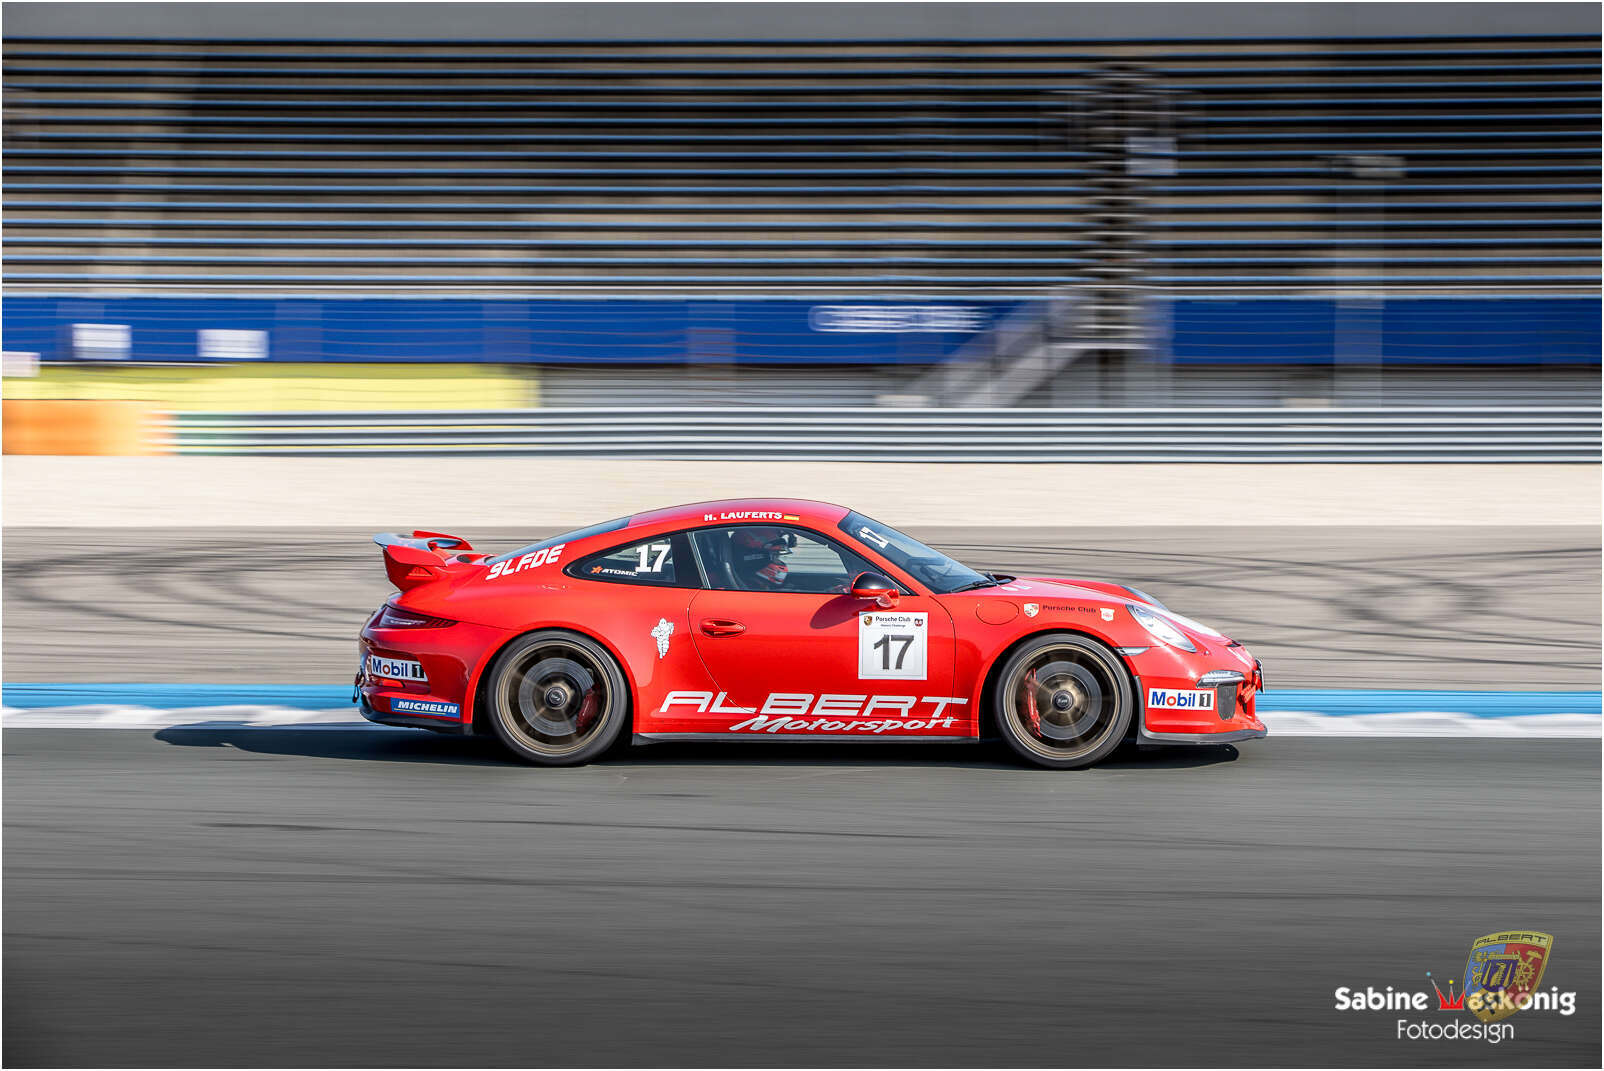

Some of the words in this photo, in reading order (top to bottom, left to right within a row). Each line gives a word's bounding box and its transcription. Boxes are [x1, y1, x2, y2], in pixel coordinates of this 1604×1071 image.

[720, 511, 783, 520] LAUFERTS
[635, 544, 671, 573] 17
[601, 568, 639, 577] ATOMIC
[1042, 604, 1075, 612] Porsche
[1077, 605, 1097, 613] Club
[873, 634, 914, 670] 17
[372, 658, 408, 677] Mobil
[397, 700, 458, 714] MICHELIN
[659, 690, 968, 718] ALBERT
[1151, 691, 1196, 707] Mobil
[729, 715, 961, 733] Motorsport
